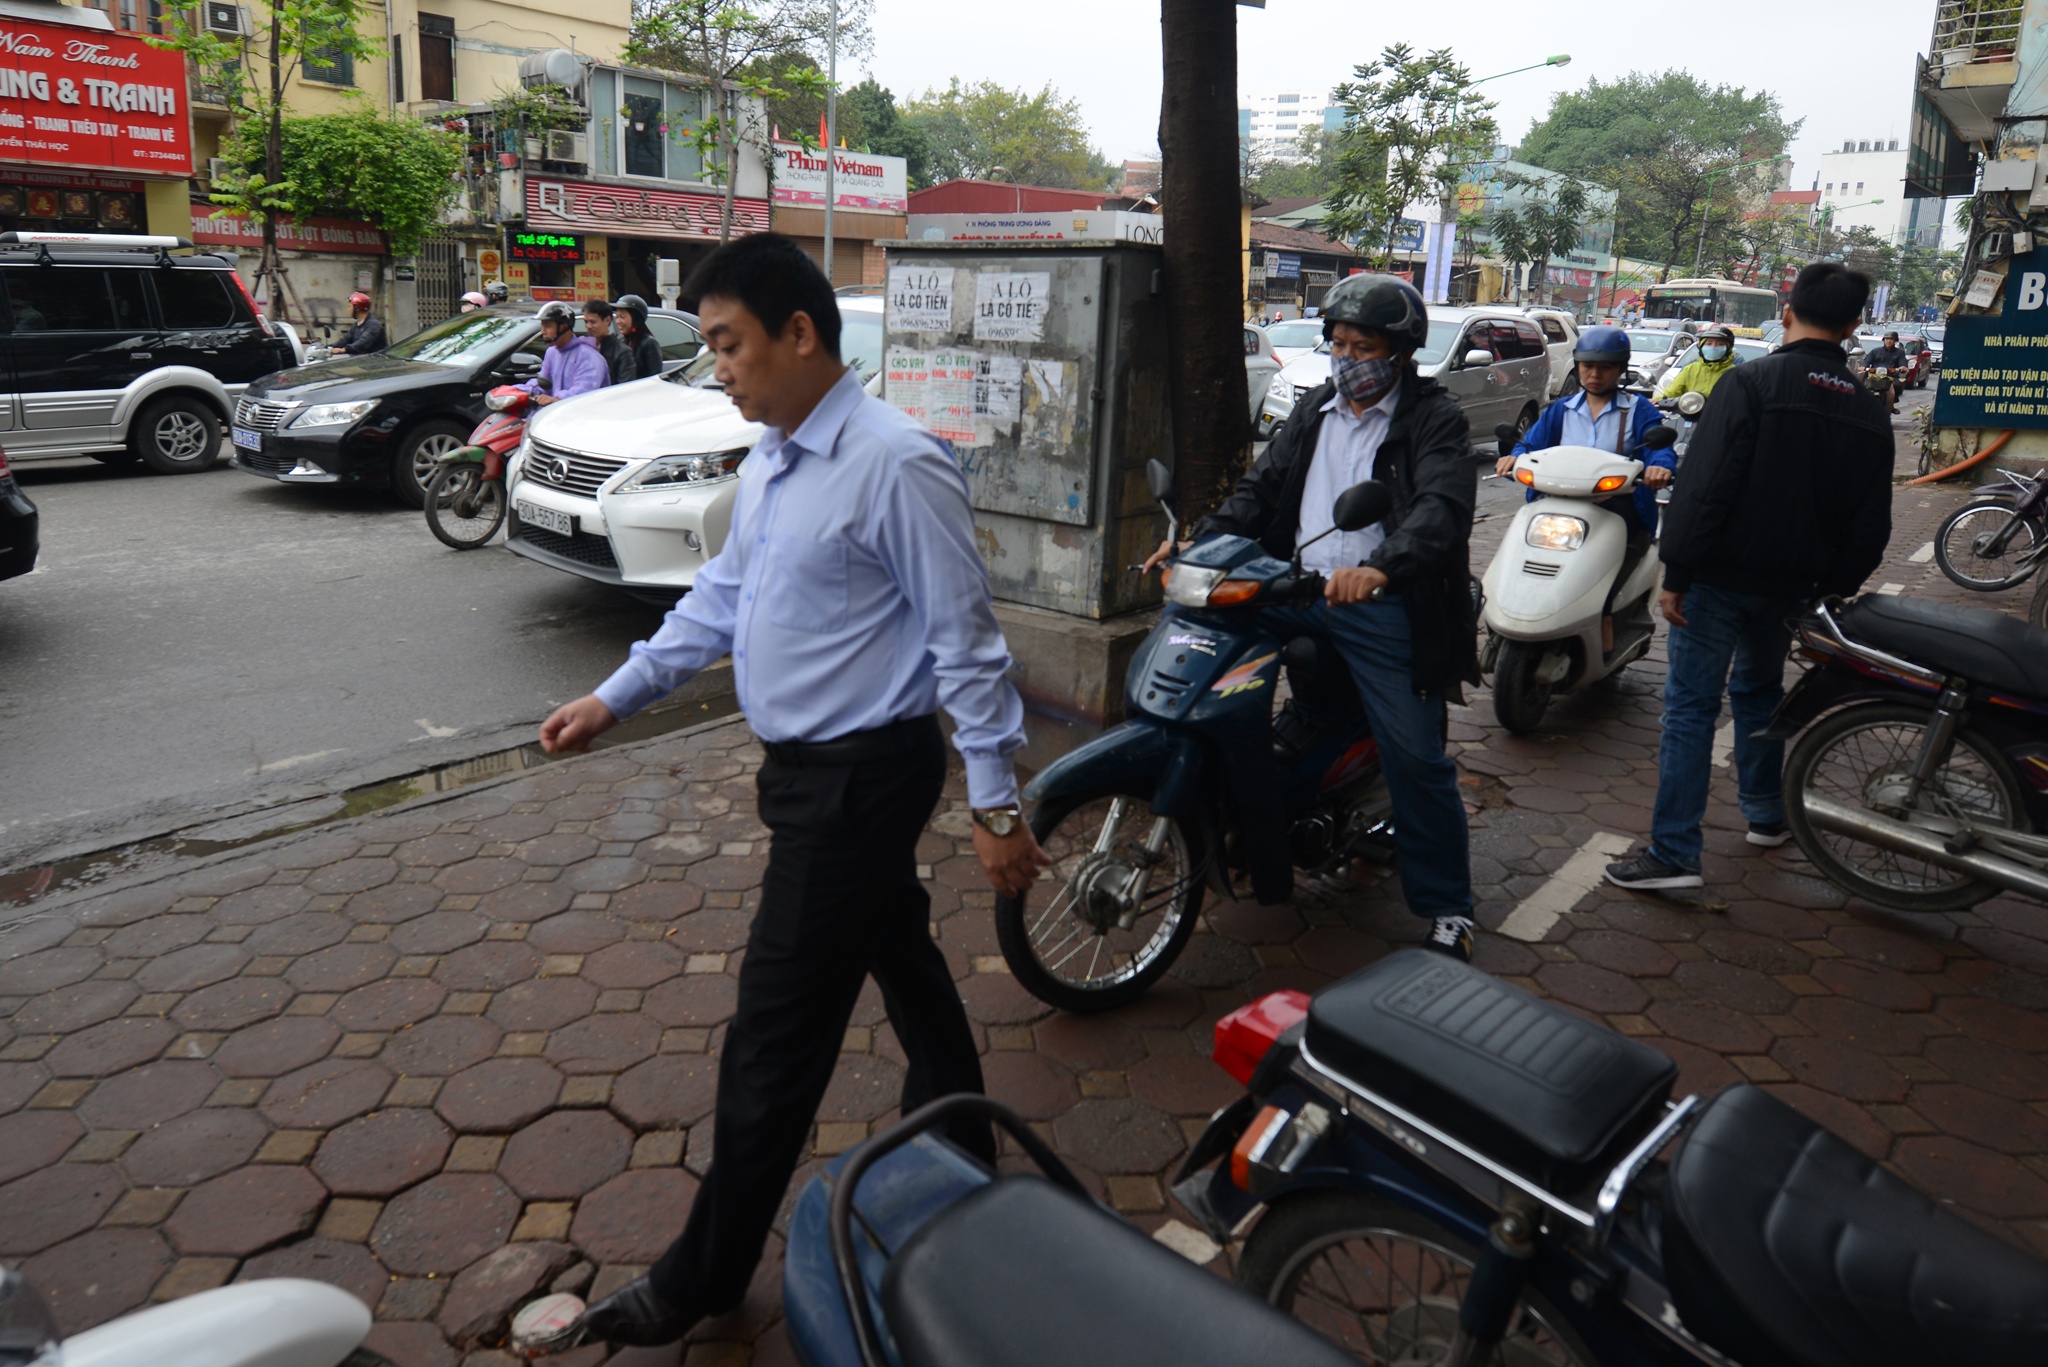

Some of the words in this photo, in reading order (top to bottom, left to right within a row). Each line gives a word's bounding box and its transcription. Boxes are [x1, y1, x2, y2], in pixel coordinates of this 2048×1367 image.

[62, 40, 140, 69] Thanh
[57, 77, 81, 105] &
[83, 77, 176, 117] TRANH
[33, 116, 70, 133] TRANH
[70, 118, 98, 135] THÊU
[99, 122, 119, 137] TAY
[127, 125, 161, 141] TRANH
[24, 139, 47, 149] THÁI
[48, 142, 69, 152] HỌC
[26, 173, 71, 185] KHUNG
[998, 220, 1015, 228] TRUNG
[321, 226, 354, 245] BÓNG
[508, 265, 524, 278] in
[1984, 333, 2003, 347] NHÀ
[2004, 334, 2029, 347] PHÂN
[1941, 368, 1959, 381] HỌC
[1960, 367, 1980, 381] VIỆN
[1982, 367, 2000, 380] ĐÀO
[2002, 369, 2019, 382] TẠO
[2020, 368, 2039, 383] VẬN
[1949, 383, 1984, 396] CHUYÊN
[1985, 386, 2000, 397] GIA
[2002, 385, 2014, 397] TƯ
[2015, 383, 2033, 398] VẤN
[1984, 400, 1996, 413] VÀ
[2009, 402, 2035, 415] NĂNG
